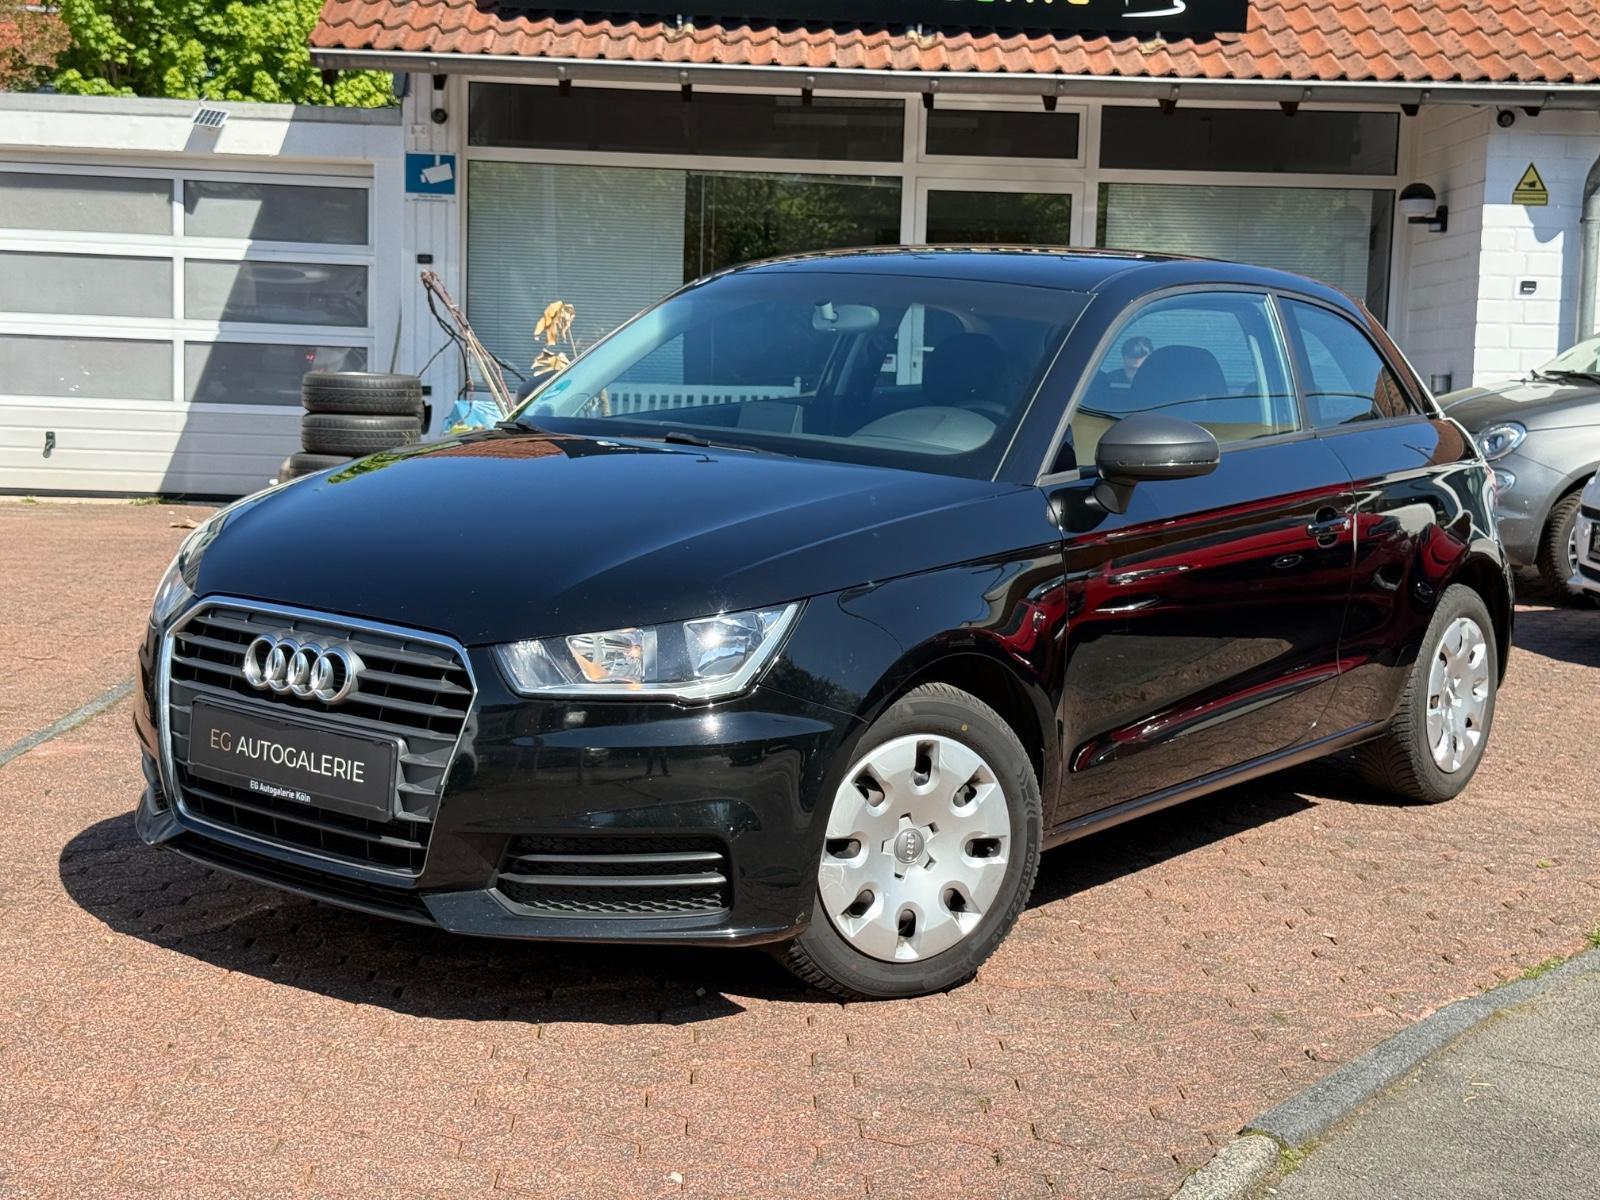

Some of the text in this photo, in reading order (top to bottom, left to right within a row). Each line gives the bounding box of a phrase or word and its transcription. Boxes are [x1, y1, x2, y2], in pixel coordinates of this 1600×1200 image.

[210, 728, 365, 783] EG AUTOGALERIE
[250, 779, 311, 803] EG Autogalerie Köln
[1006, 842, 1035, 920] FORTEZZA
